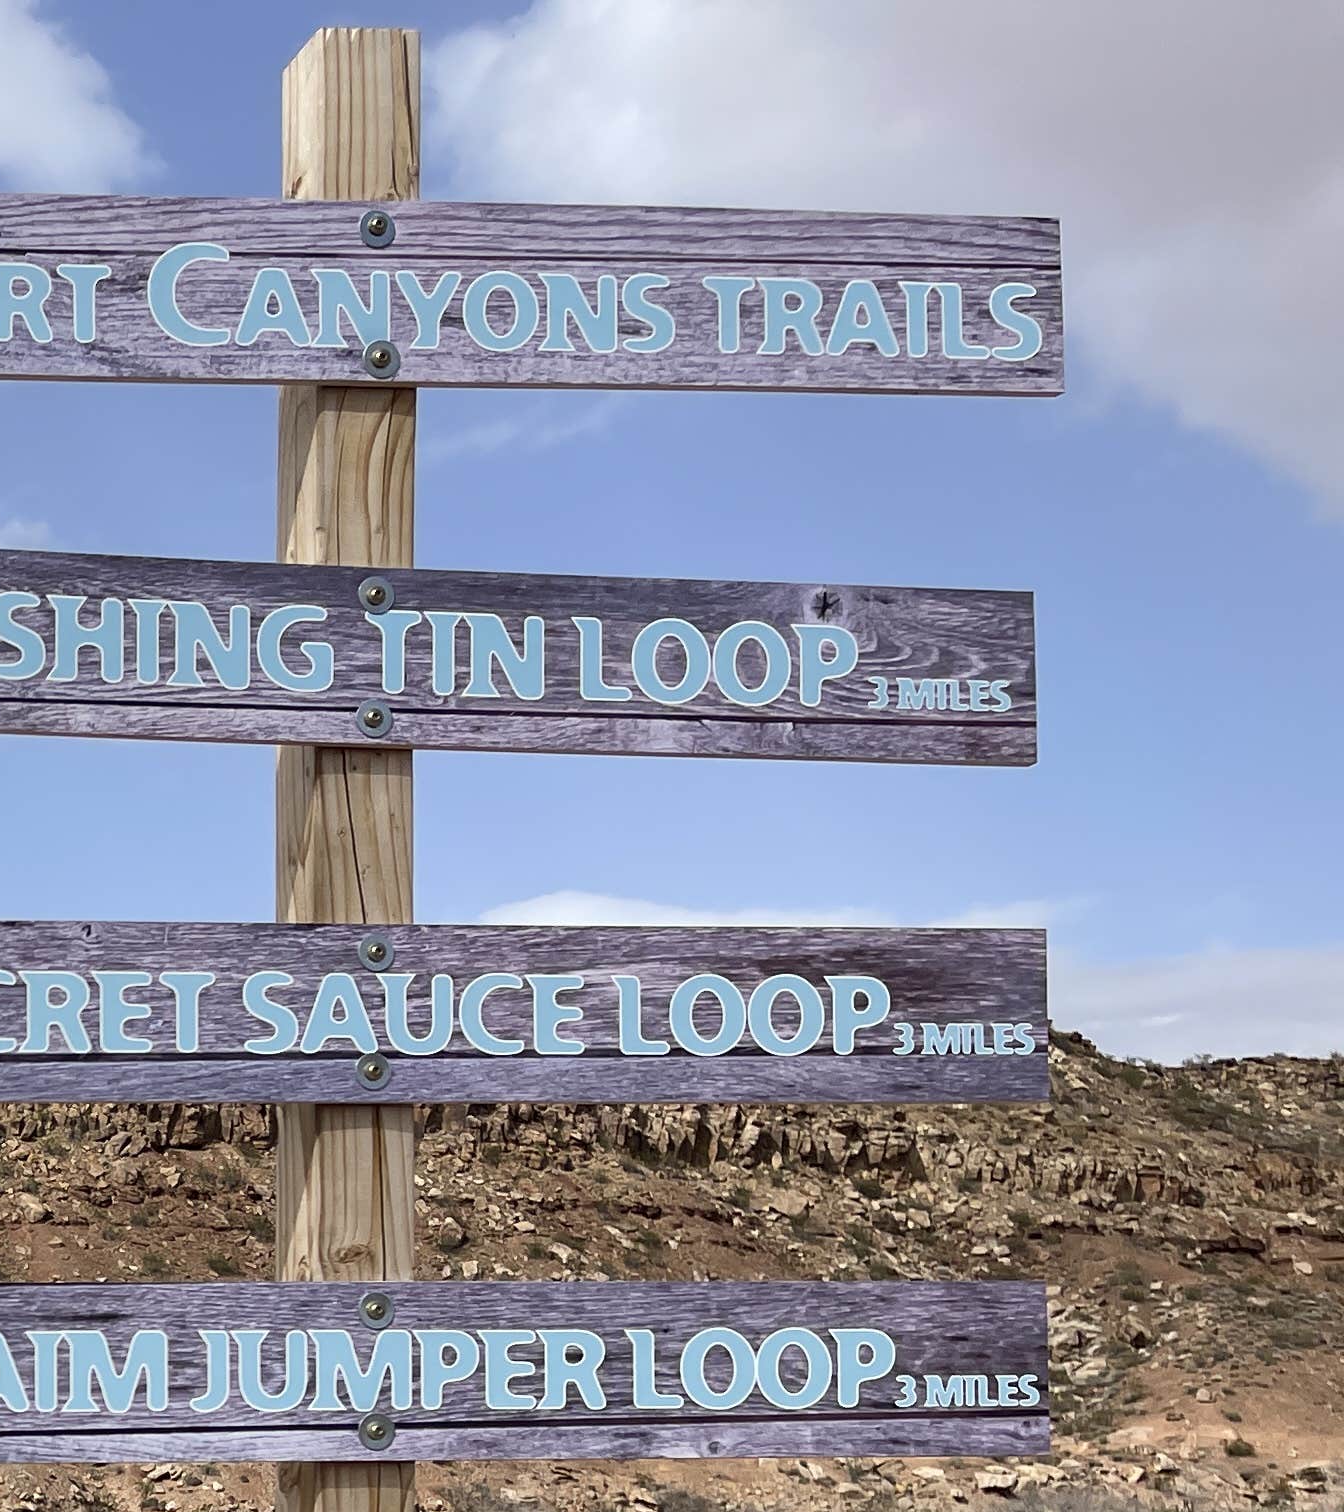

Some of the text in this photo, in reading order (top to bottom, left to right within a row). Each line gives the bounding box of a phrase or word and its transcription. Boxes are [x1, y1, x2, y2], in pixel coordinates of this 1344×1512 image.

[148, 243, 675, 354] CANYONS
[703, 276, 1043, 362] TRAILS
[365, 610, 546, 701] TIN
[570, 617, 860, 707] LOOP
[867, 675, 891, 709] 3
[895, 677, 1013, 713] MILES
[242, 971, 586, 1056] SAUCE
[611, 973, 892, 1057] LOOP
[892, 1022, 916, 1056] 3
[921, 1022, 1036, 1056] MILES
[189, 1327, 607, 1413] JUMPER
[624, 1326, 897, 1411] LOOP
[894, 1374, 918, 1408] 3
[923, 1373, 1041, 1408] MILES
